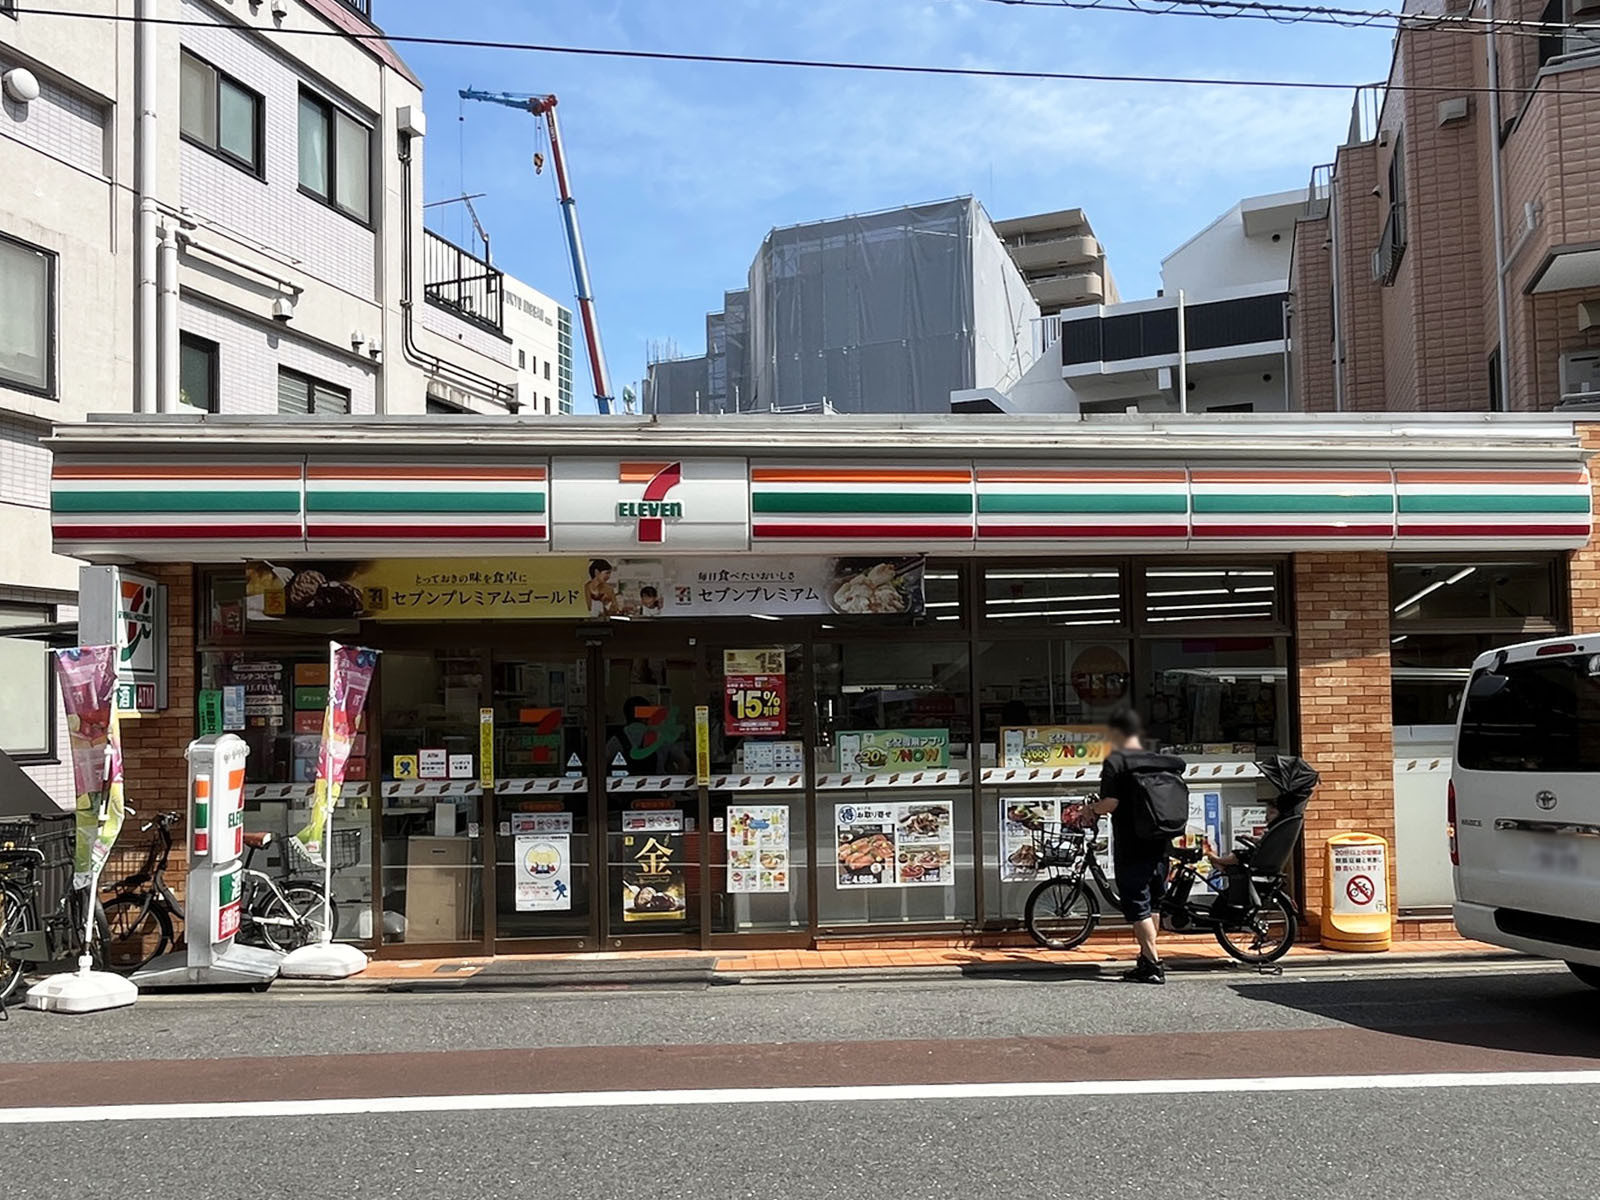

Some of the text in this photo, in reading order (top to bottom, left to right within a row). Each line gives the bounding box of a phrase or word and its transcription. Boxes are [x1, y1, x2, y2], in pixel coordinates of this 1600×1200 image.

[391, 588, 580, 607] セブンプレミアムゴールド
[698, 586, 819, 603] セブンプレミアム
[634, 837, 674, 876] 金
